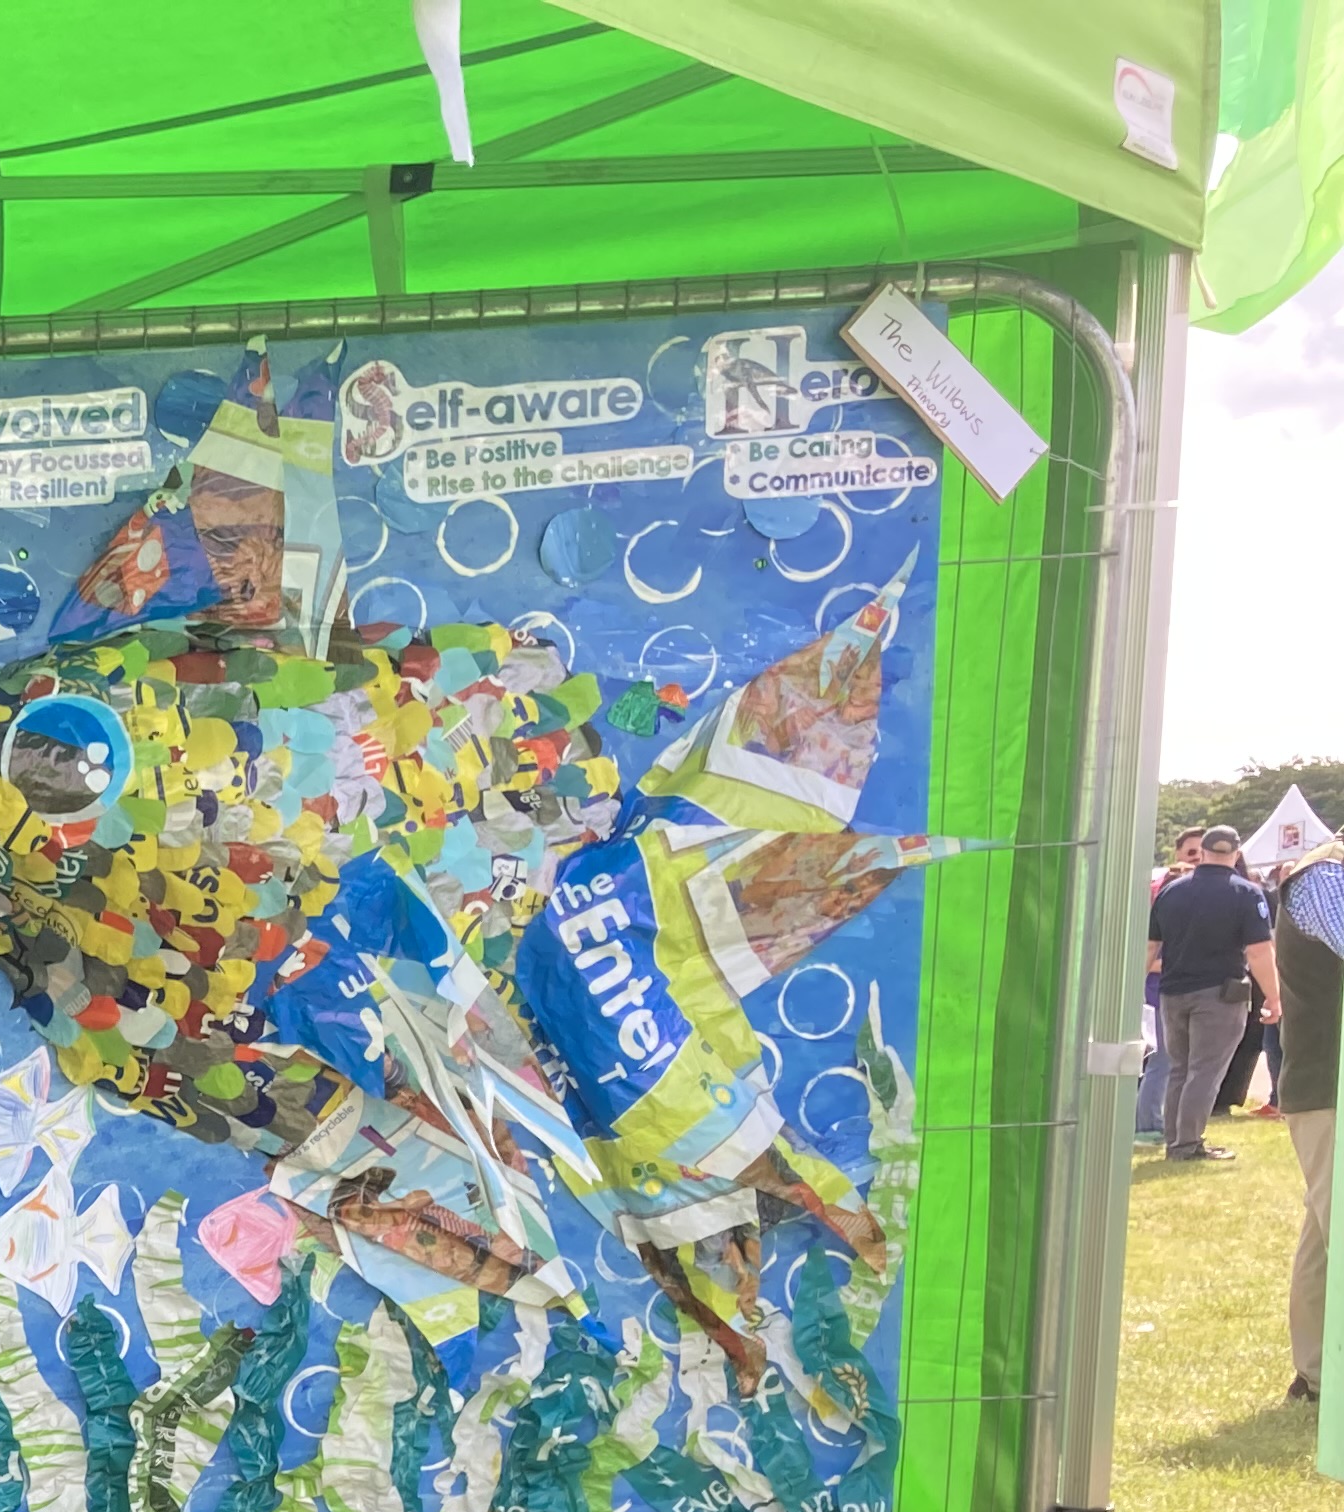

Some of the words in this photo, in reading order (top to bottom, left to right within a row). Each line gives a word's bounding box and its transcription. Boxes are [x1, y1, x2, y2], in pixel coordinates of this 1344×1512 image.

[879, 313, 912, 362] The
[714, 333, 898, 436] Hero
[906, 374, 950, 430] Primary
[925, 360, 983, 437] Willows
[343, 361, 637, 463] Self-aware
[29, 446, 146, 473] Focussed
[425, 450, 456, 471] Be
[464, 440, 557, 466] Positive
[749, 441, 781, 463] Be
[788, 435, 873, 459] Caring
[9, 476, 108, 502] Resilient
[427, 475, 475, 498] Rise
[481, 471, 506, 492] to
[513, 466, 554, 489] the
[561, 451, 689, 484] challenge
[748, 462, 931, 493] Communicate
[549, 871, 616, 916] The
[309, 1103, 356, 1148] recyclable
